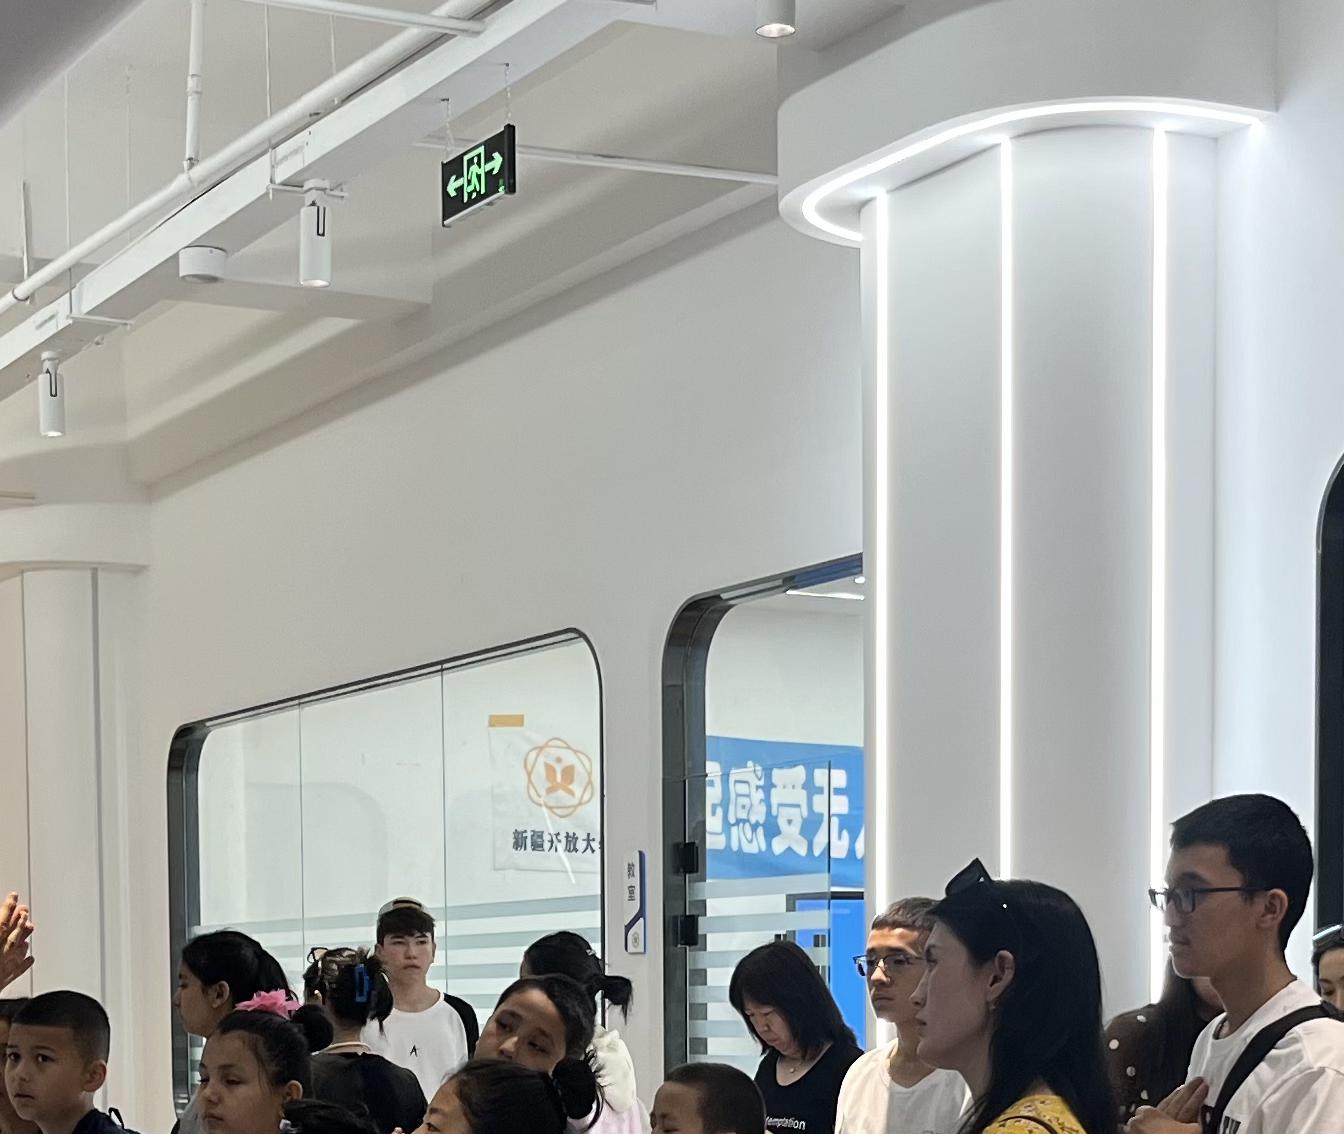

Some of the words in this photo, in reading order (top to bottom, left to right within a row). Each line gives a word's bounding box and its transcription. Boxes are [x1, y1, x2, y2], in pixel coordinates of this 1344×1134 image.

[512, 828, 601, 854] 新疆开放大
[706, 760, 864, 860] 感受无
